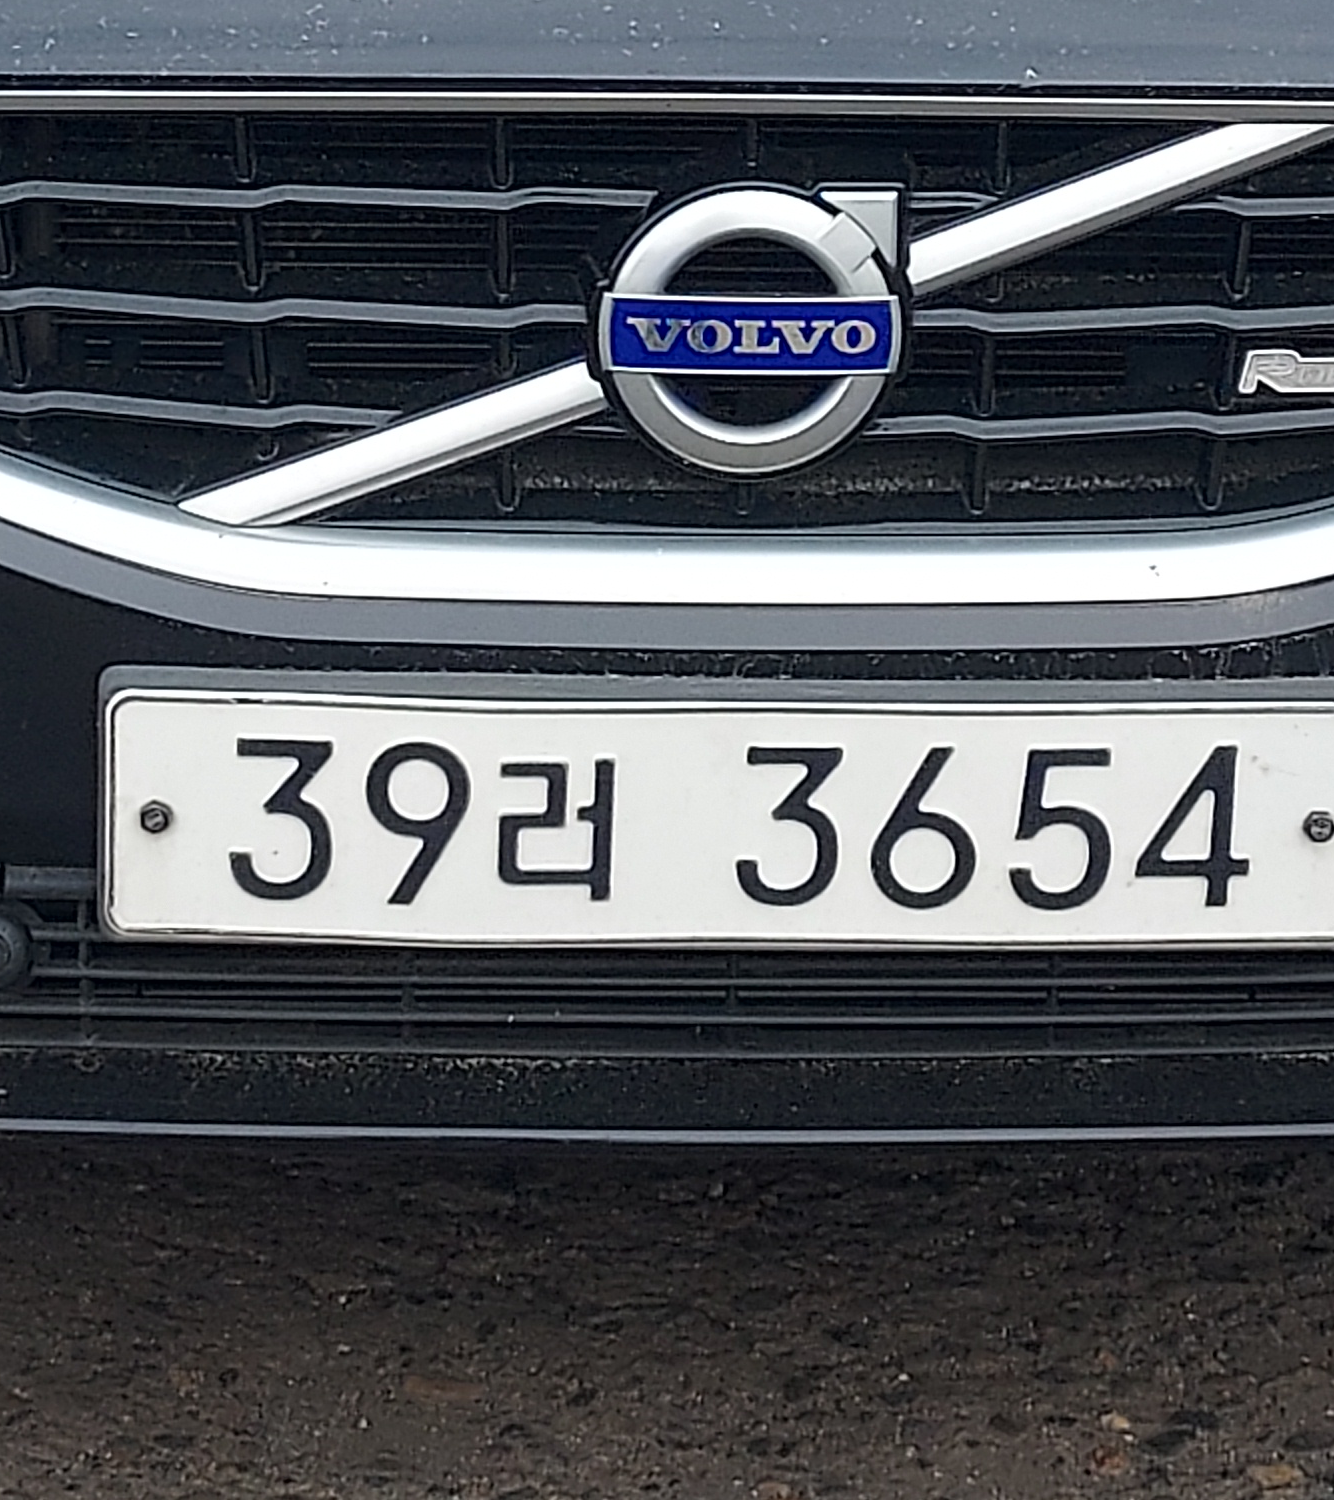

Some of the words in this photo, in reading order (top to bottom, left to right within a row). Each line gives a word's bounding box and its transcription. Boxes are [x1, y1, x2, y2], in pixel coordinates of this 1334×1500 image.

[625, 316, 877, 355] VOLVO
[229, 736, 616, 905] 39러
[736, 745, 1250, 910] 3654
